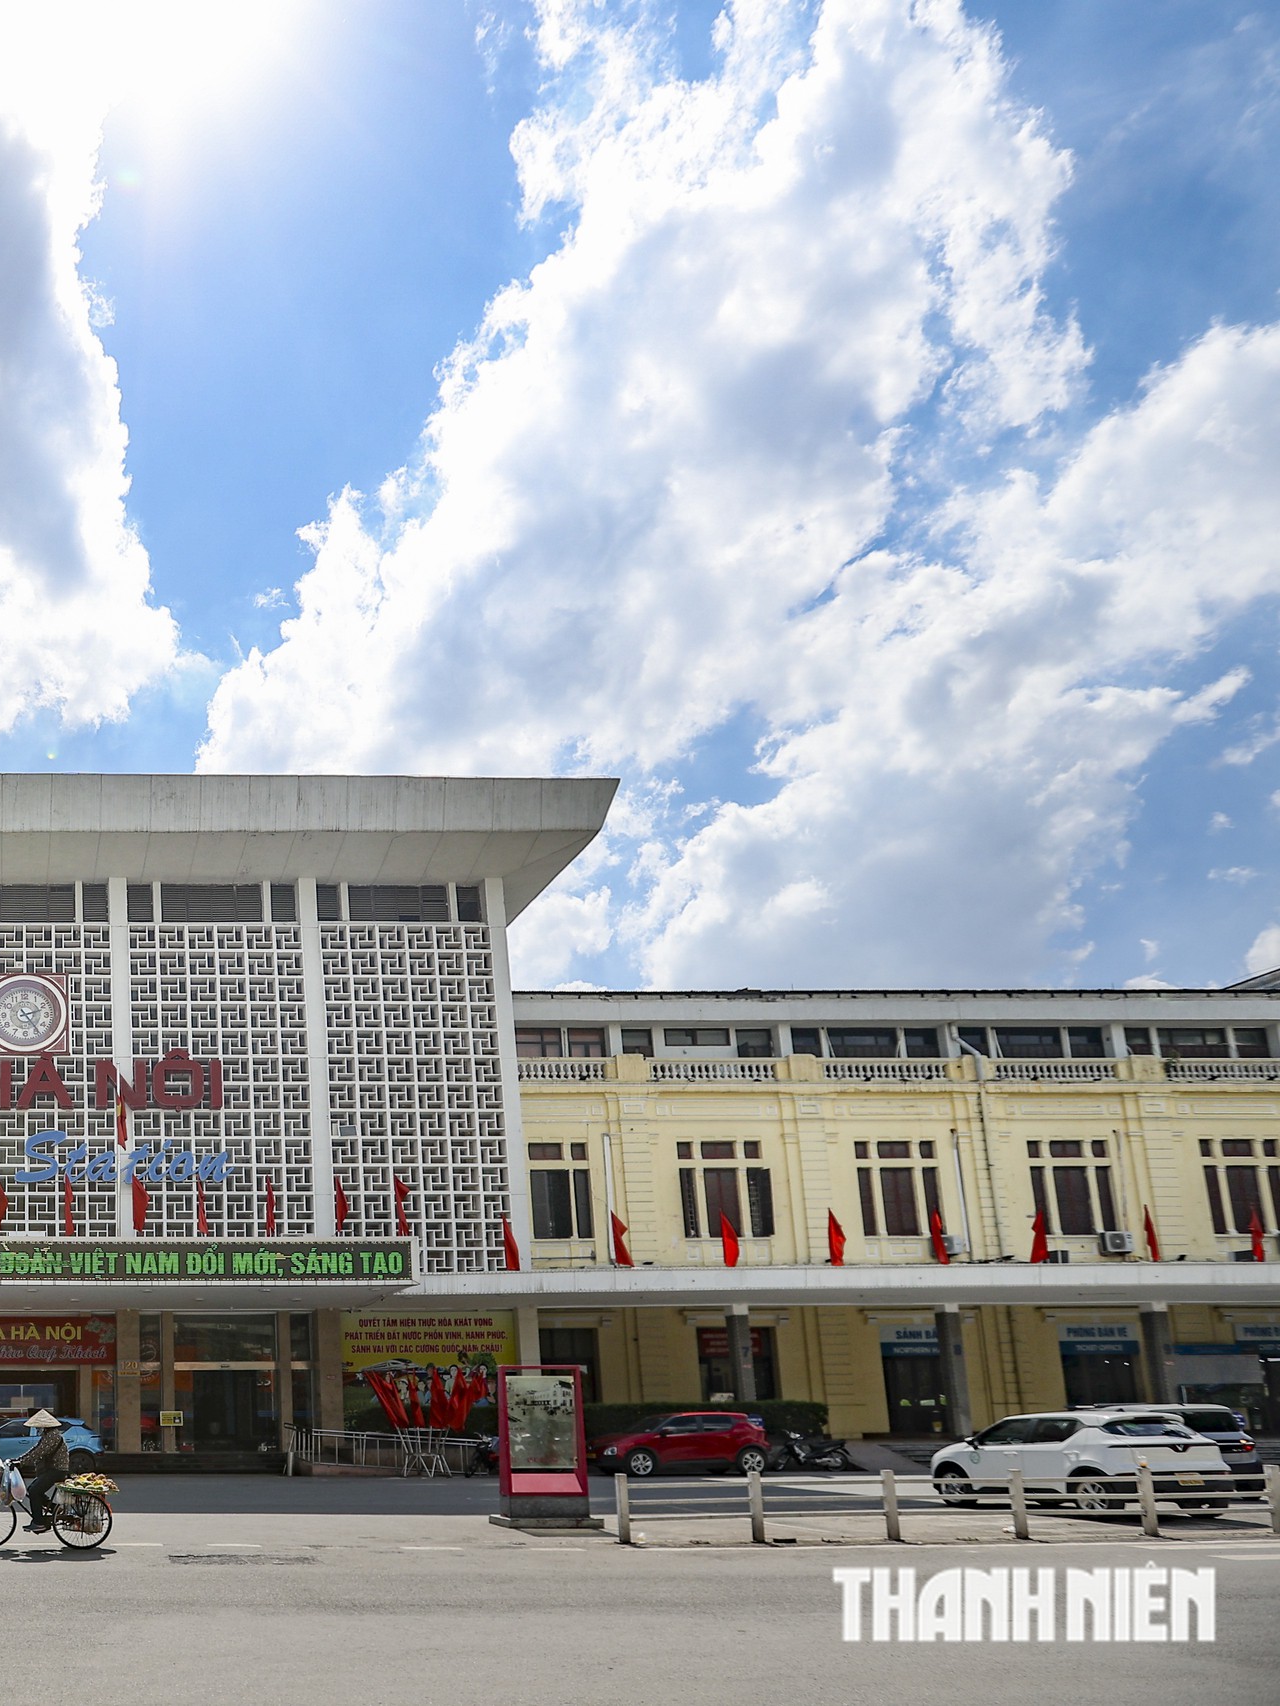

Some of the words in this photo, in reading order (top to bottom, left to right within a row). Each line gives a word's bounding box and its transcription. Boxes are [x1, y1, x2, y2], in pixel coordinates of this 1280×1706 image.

[94, 1047, 223, 1112] NỘI
[15, 1130, 235, 1184] Station
[70, 1247, 118, 1279] VIỆT
[125, 1251, 179, 1275] NAM
[186, 1243, 225, 1275] ĐỔI
[290, 1247, 354, 1275] SÁNG
[359, 1251, 403, 1279] TẠO
[358, 1317, 380, 1328] QUYẾT
[383, 1317, 397, 1327] TÂM
[400, 1317, 416, 1328] HIỆN
[418, 1318, 436, 1328] THỰC
[454, 1317, 472, 1327] KHÁT
[474, 1318, 493, 1328] VỌNG
[10, 1322, 40, 1340] HÀ
[45, 1322, 82, 1344] NỘI
[344, 1330, 363, 1340] PHÁT
[365, 1328, 385, 1340] TRIỂN
[387, 1330, 400, 1340] ĐẤT
[466, 1331, 485, 1341] HẠNH
[896, 1327, 922, 1339] SẢNH
[26, 1344, 57, 1362] Quý
[59, 1344, 108, 1359] Khách
[373, 1345, 384, 1353] VAI
[741, 1346, 750, 1358] 7
[120, 1361, 138, 1370] 120
